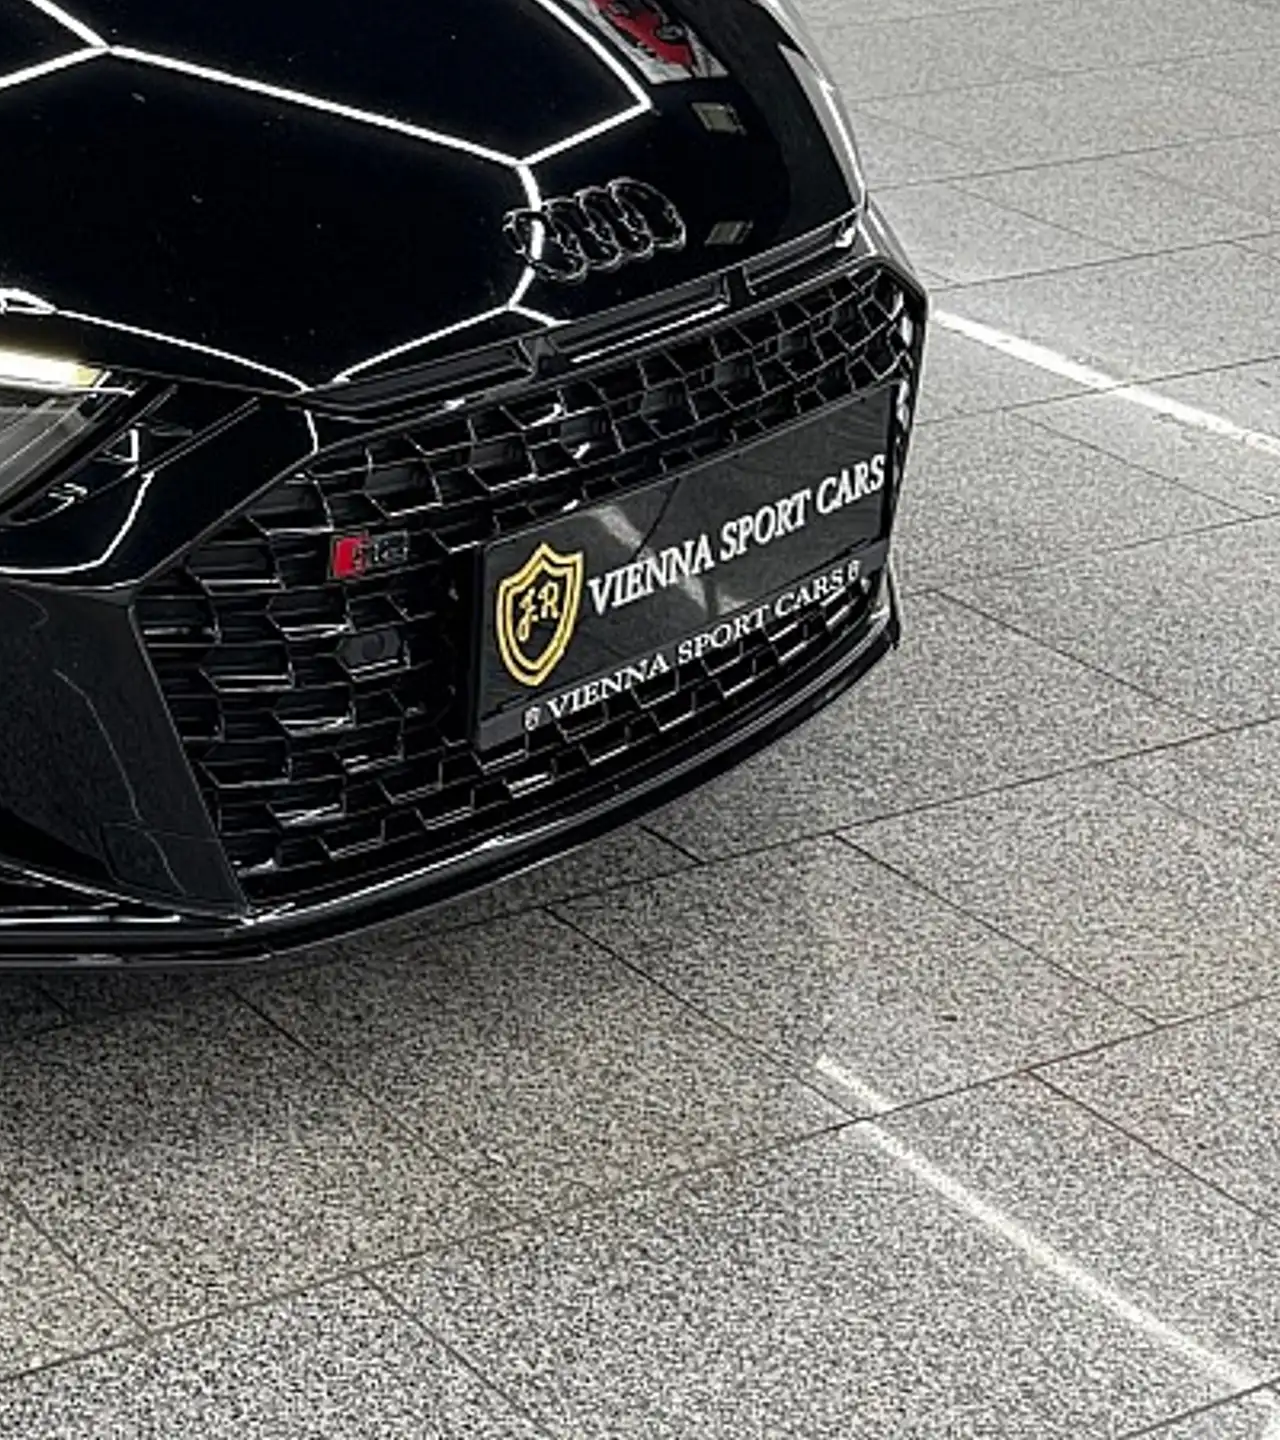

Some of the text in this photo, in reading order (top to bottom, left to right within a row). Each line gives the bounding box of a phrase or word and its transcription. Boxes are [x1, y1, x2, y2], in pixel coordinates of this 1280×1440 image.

[587, 454, 885, 615] VIENNA SPORT CARS
[546, 566, 844, 719] VIENNA SPORT CARS
